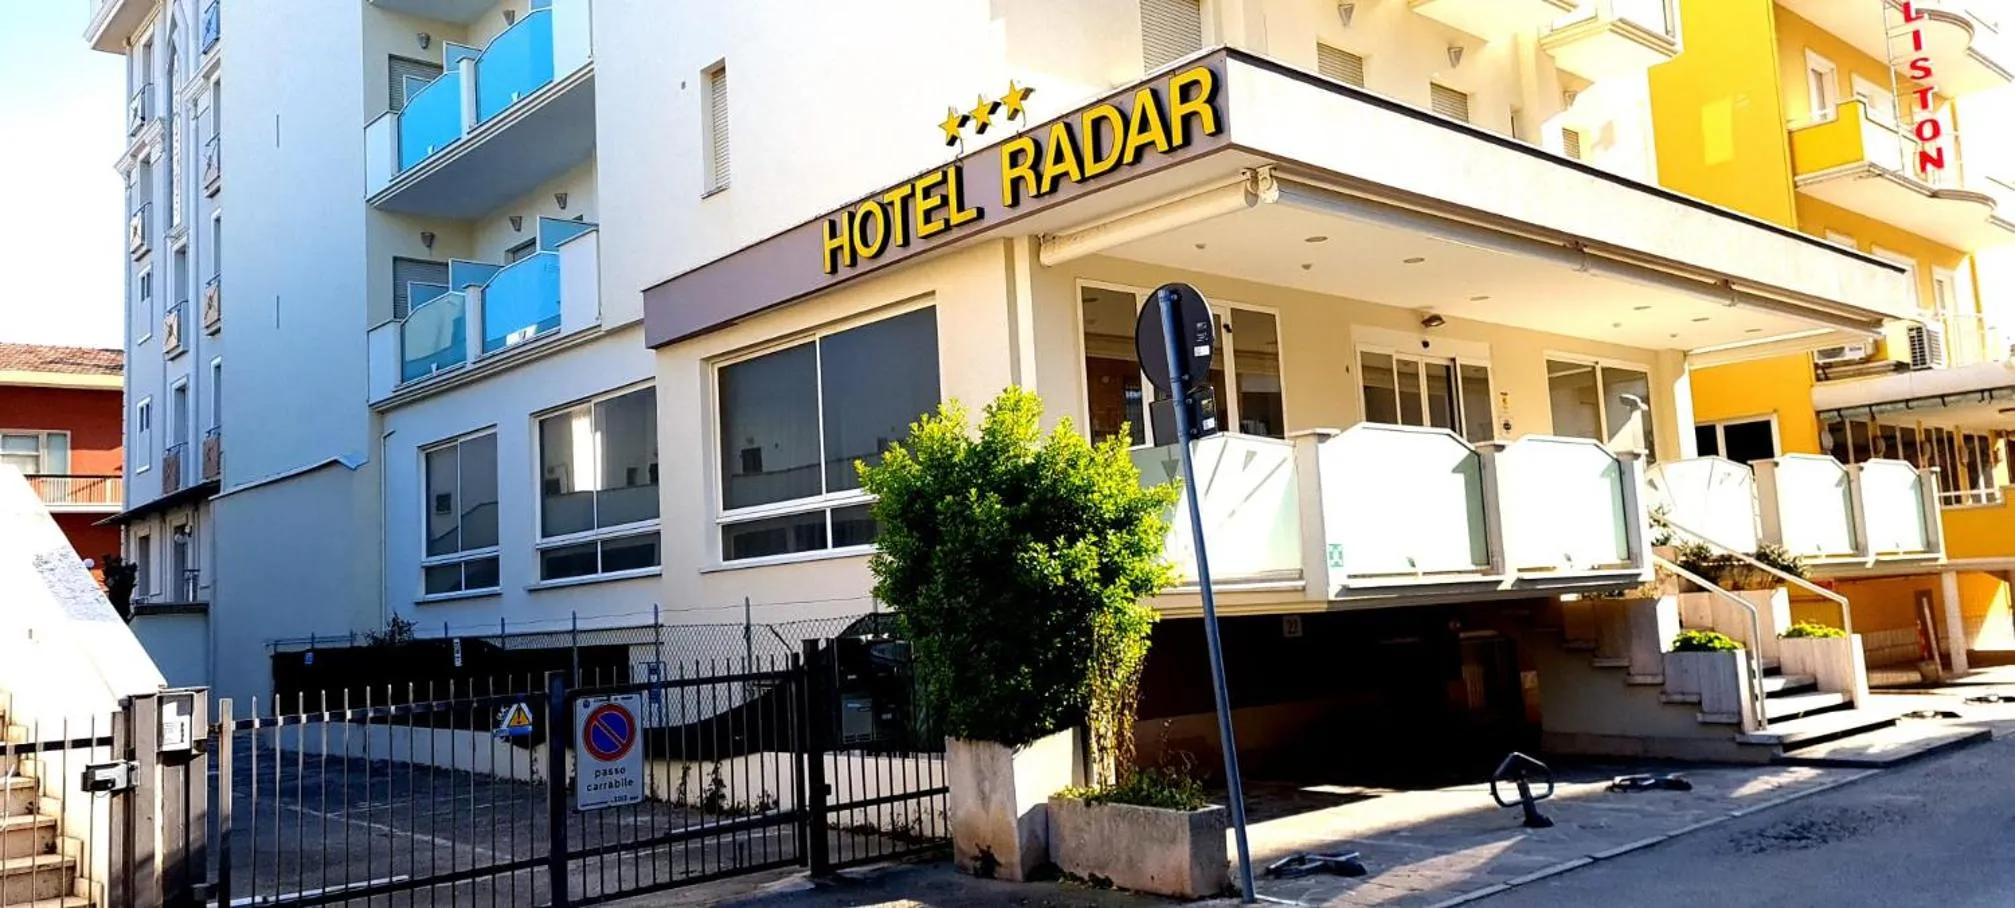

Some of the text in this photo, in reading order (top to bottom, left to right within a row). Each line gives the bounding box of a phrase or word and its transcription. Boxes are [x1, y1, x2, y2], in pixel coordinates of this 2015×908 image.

[1902, 2, 1945, 174] LISTON
[822, 66, 1211, 274] HOTEL RADAR
[586, 777, 635, 791] carrabile
[594, 767, 626, 779] passo
